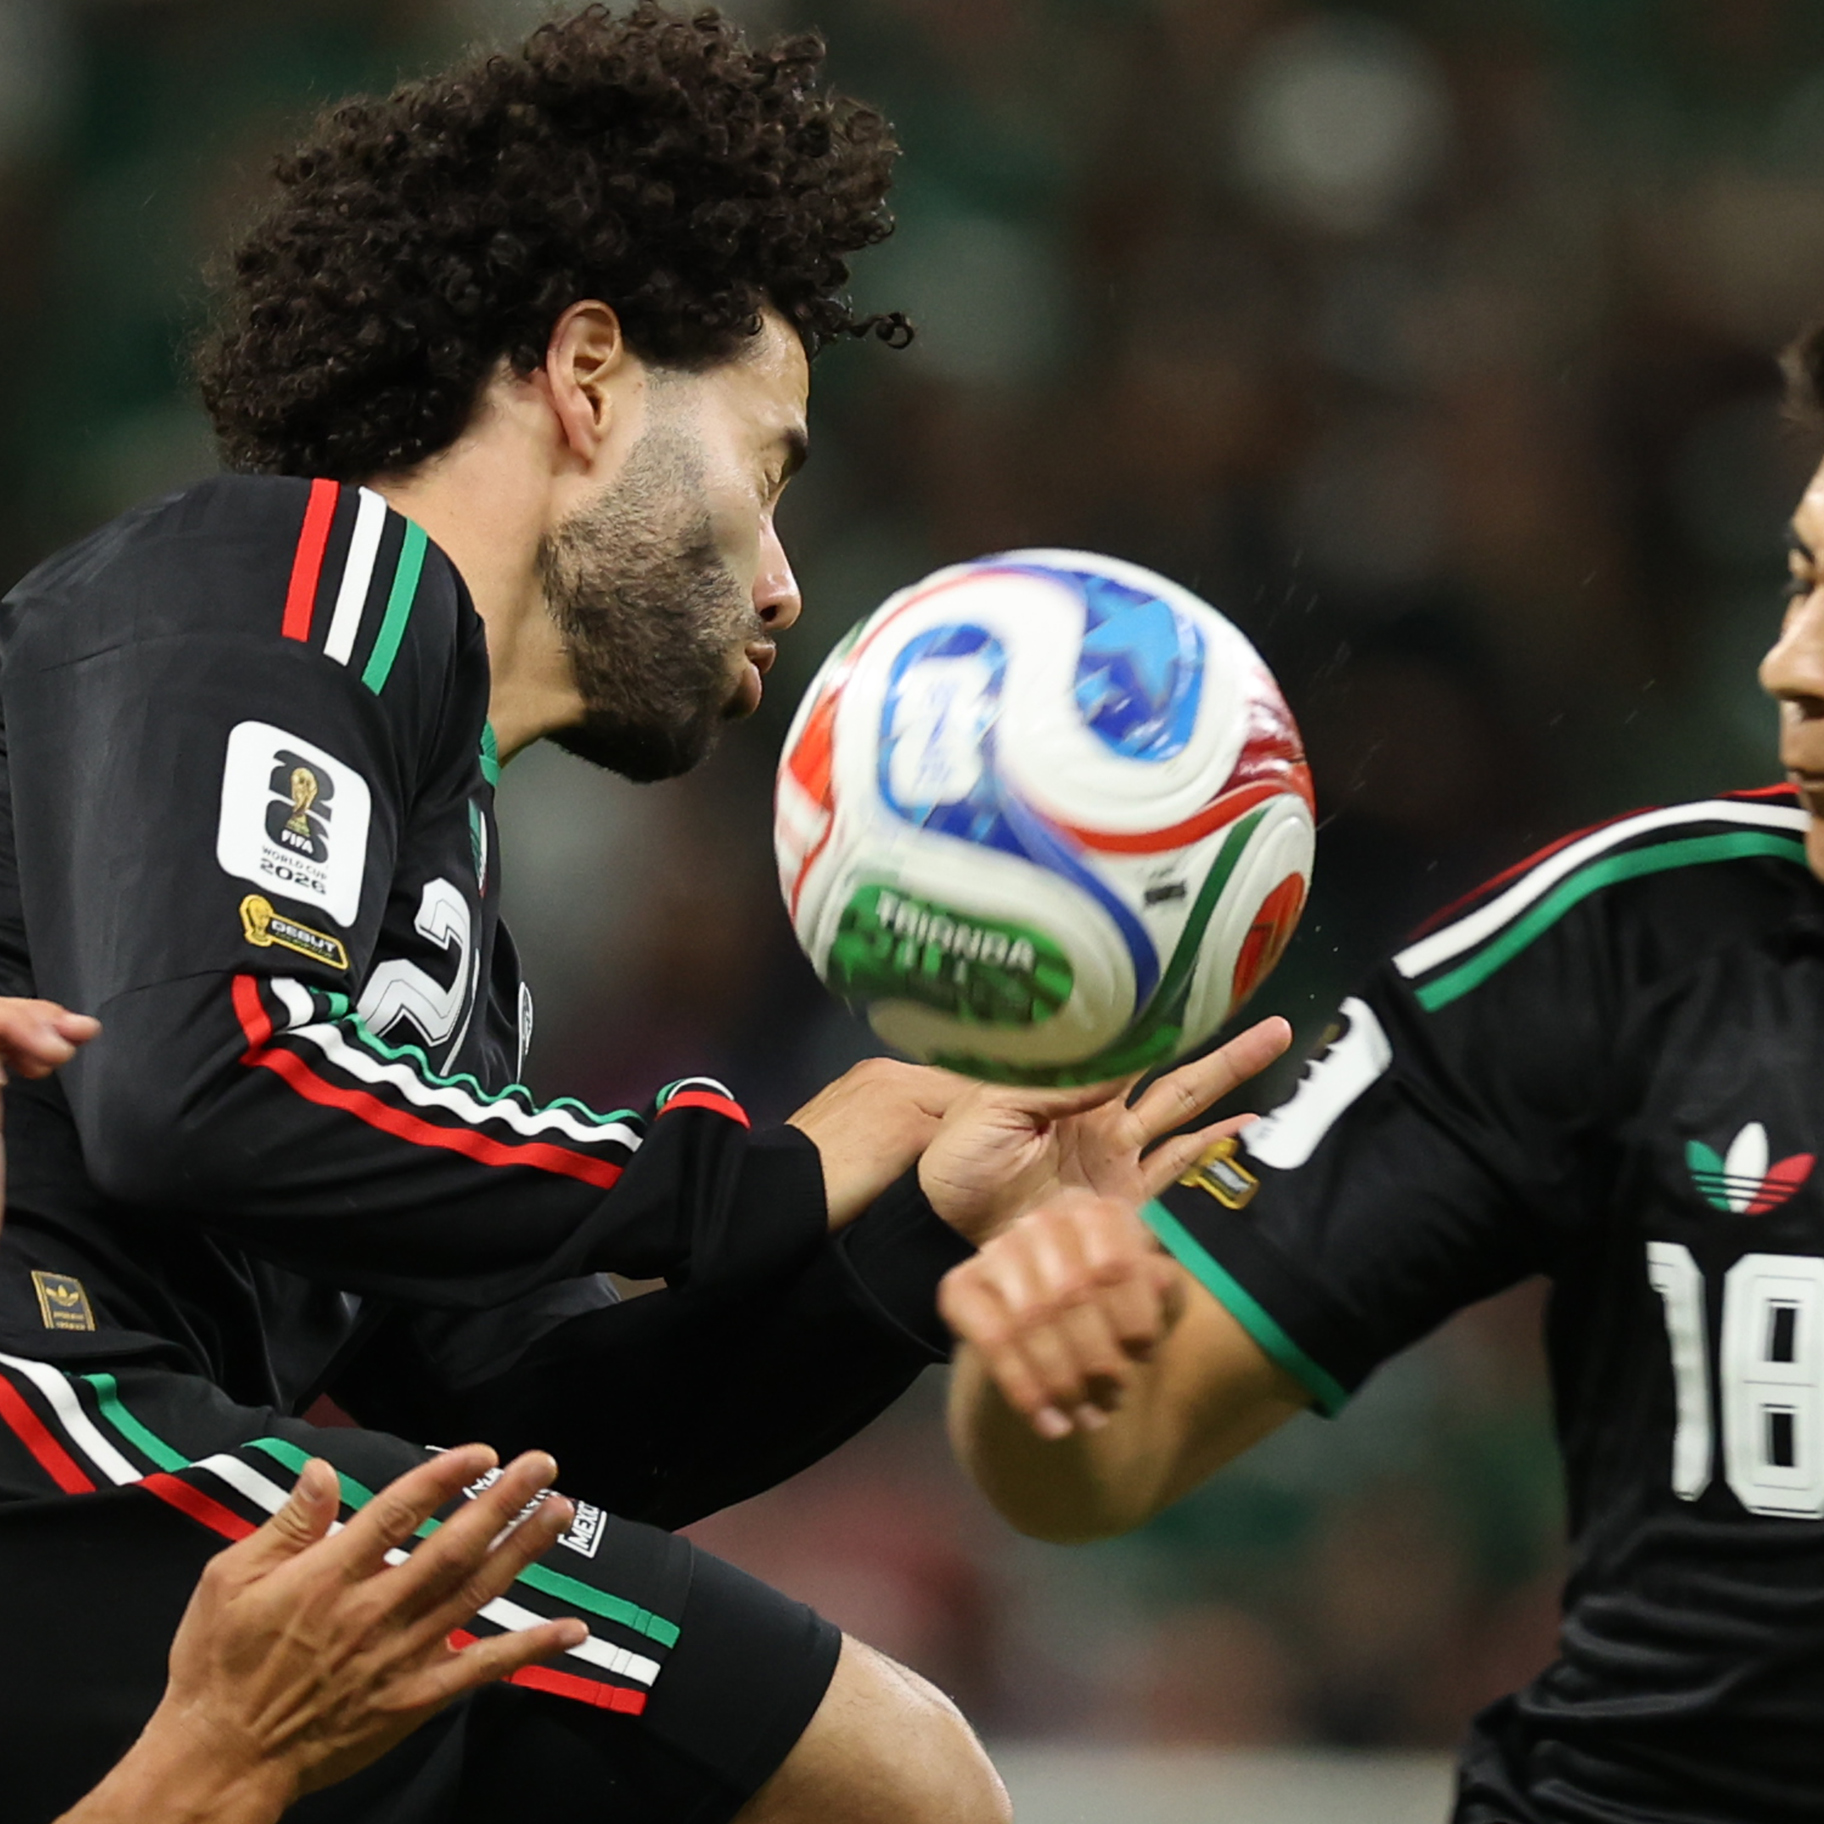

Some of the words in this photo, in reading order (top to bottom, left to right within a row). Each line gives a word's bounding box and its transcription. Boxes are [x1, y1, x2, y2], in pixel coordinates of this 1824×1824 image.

[281, 829, 314, 854] FIFA
[262, 845, 304, 870] WORLD
[260, 857, 327, 896] 2026
[271, 920, 336, 952] DEBUT
